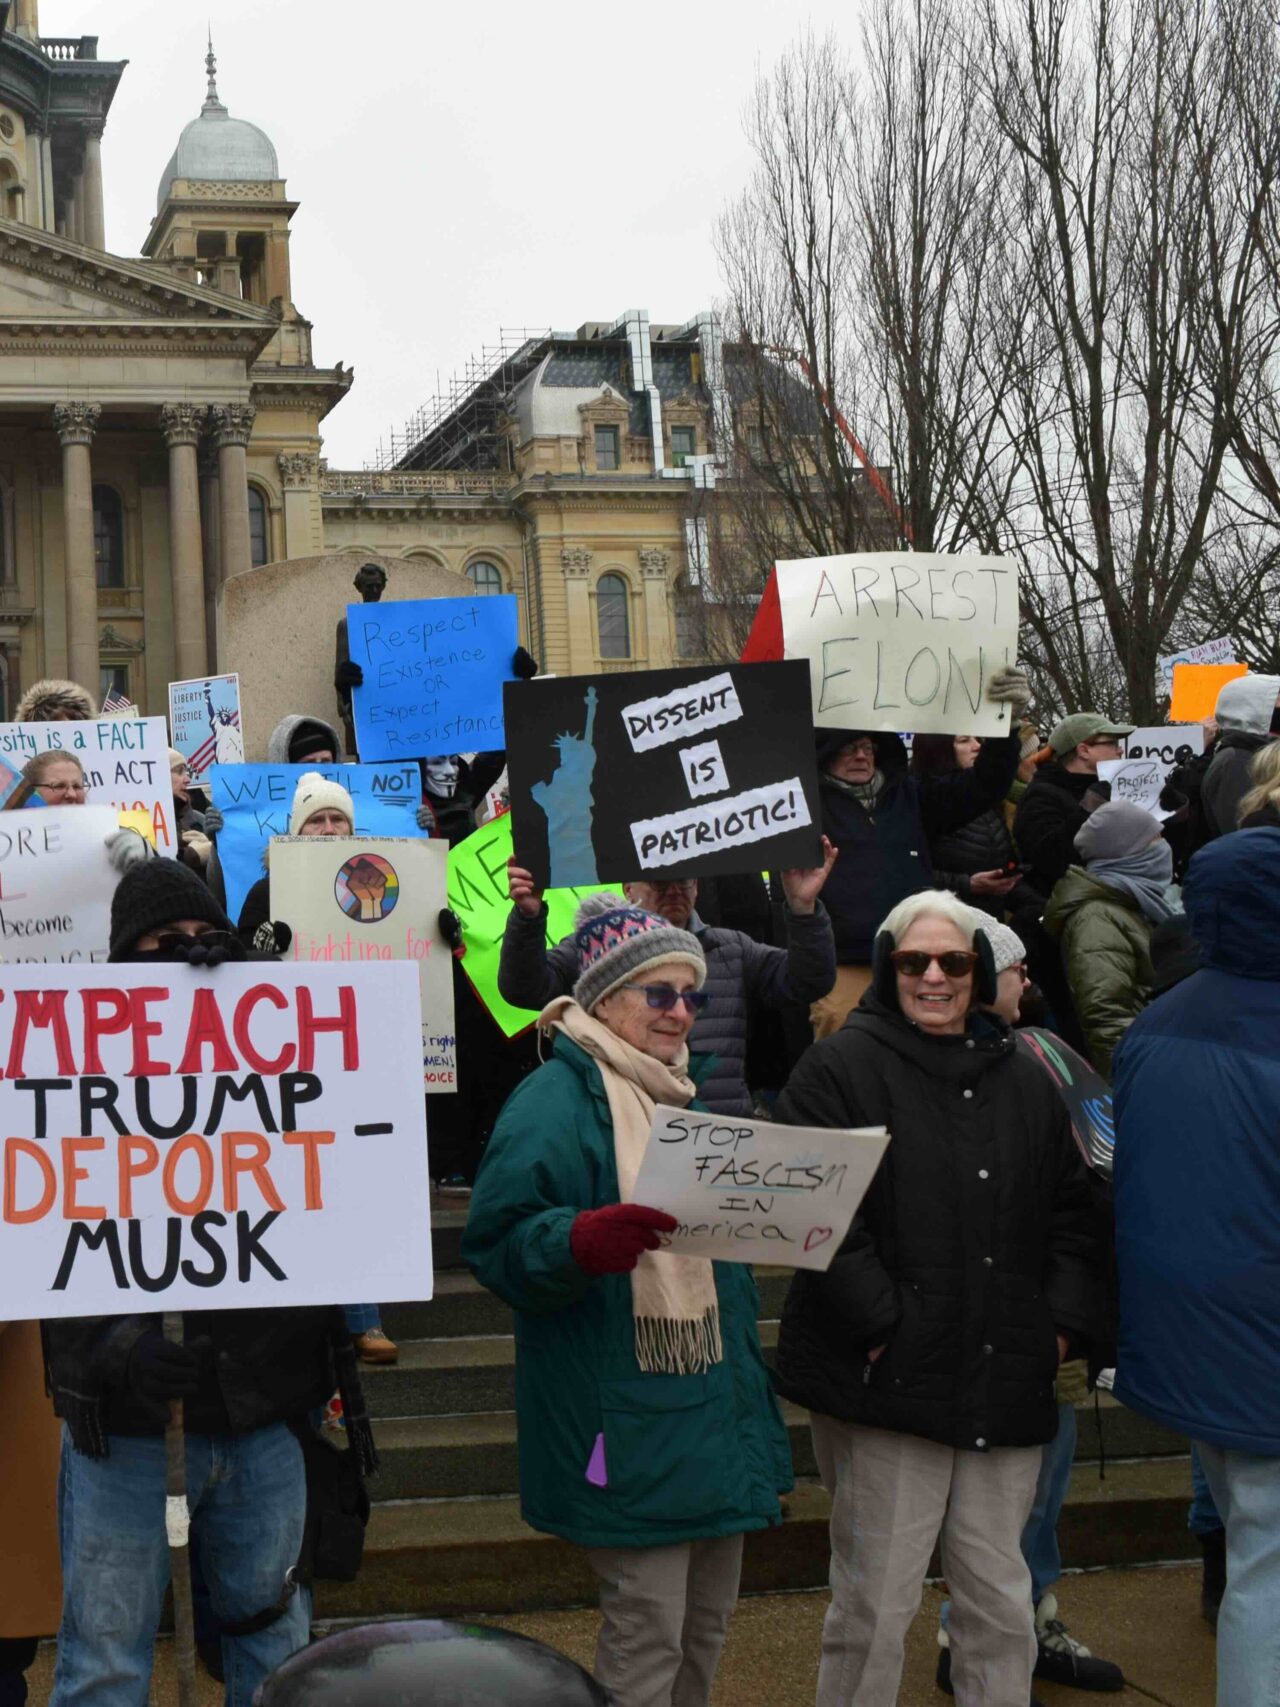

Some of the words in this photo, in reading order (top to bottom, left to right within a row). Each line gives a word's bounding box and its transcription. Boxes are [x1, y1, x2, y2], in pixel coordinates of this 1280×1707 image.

[811, 565, 1008, 624] ARREST
[363, 607, 480, 666] Respect
[378, 648, 486, 688] Existence
[424, 674, 450, 694] OR
[818, 637, 1008, 720] ELON!
[174, 691, 202, 704] LIBERTY
[370, 700, 440, 726] Expect
[628, 686, 732, 738] DISSENT
[174, 710, 202, 723] JUSTICE
[386, 715, 503, 751] Resistanc
[47, 728, 63, 750] is
[73, 731, 86, 747] a
[96, 722, 147, 751] FACT
[175, 731, 188, 742] ALL
[114, 761, 157, 785] ACT
[221, 775, 286, 803] WE
[371, 769, 418, 793] NOT
[690, 757, 718, 785] IS
[641, 790, 797, 858] PATRIOTIC!
[0, 907, 73, 940] become
[406, 927, 433, 961] for
[424, 1072, 454, 1083] HOICE
[14, 1071, 322, 1139] TRUMP
[659, 1118, 754, 1151] STOP
[3, 1130, 336, 1224] DEPORT
[719, 1196, 774, 1214] IN
[48, 1210, 288, 1292] MUSK
